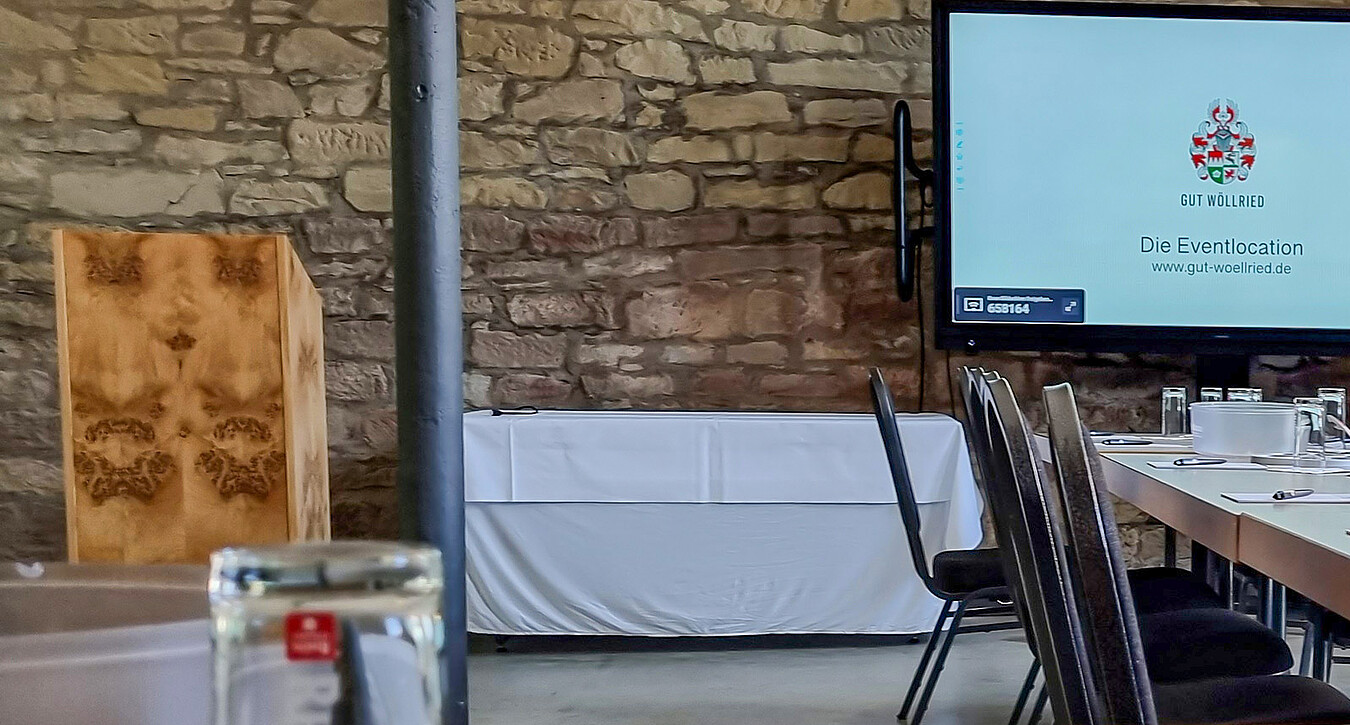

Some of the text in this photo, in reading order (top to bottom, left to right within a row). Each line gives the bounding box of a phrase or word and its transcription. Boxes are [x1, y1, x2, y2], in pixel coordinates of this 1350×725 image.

[1180, 191, 1265, 208] GUT WÖLLRIED
[1140, 236, 1304, 256] Die Eventlocation
[1151, 261, 1292, 276] www.gut-woellried.de
[987, 303, 1030, 314] 658164
